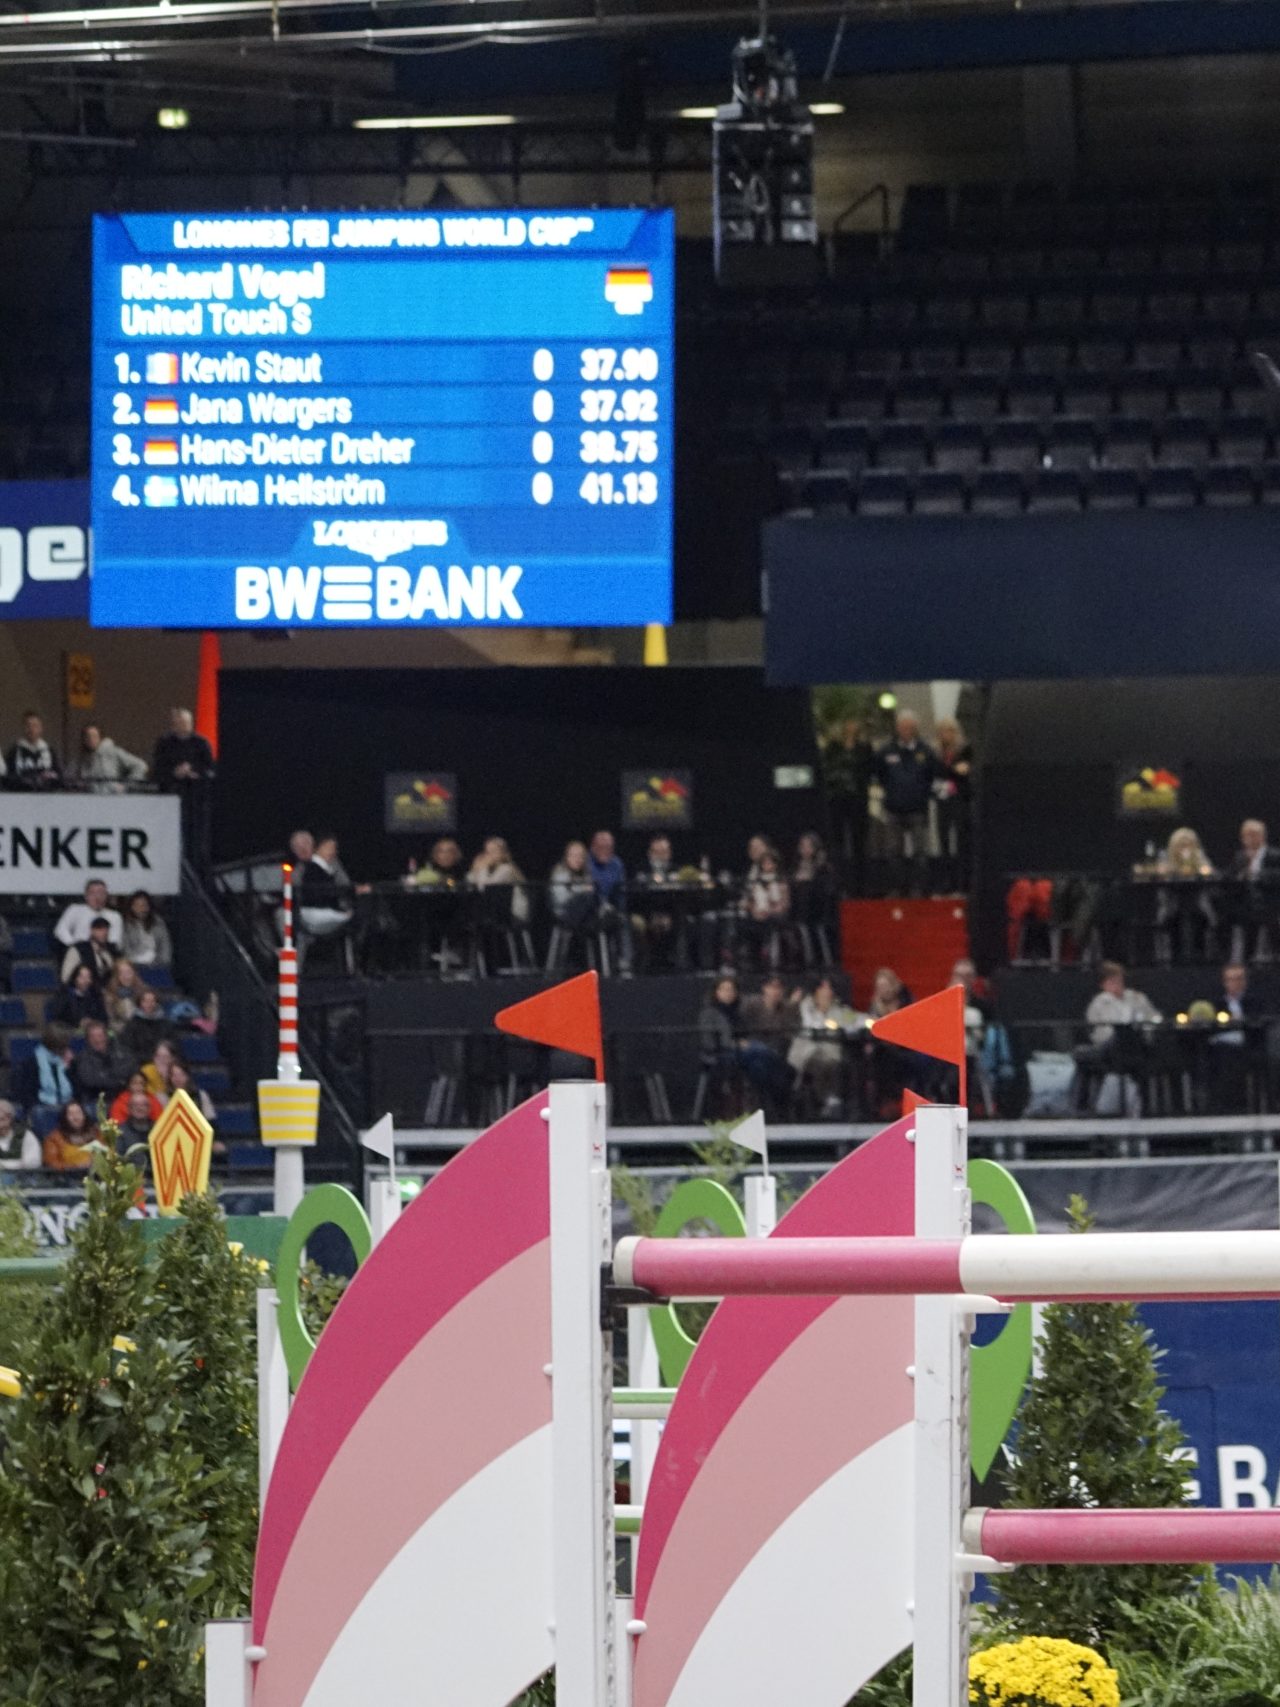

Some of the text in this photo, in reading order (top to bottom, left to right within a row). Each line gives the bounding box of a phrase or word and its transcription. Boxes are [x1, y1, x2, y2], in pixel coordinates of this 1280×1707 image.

[292, 219, 329, 247] FEI
[332, 218, 440, 247] JUMPING
[442, 217, 526, 246] WORLD
[122, 261, 325, 307] Richard Vogel
[121, 301, 311, 335] United Touch S
[114, 352, 141, 384] 1.
[181, 351, 250, 383] Kevin
[255, 350, 322, 383] Staut
[532, 348, 554, 381] 0
[112, 388, 659, 430] 2. Jana Wargers 0 37.92
[112, 433, 141, 465] 3.
[181, 431, 327, 465] Hans-Dieter
[331, 431, 415, 465] Dreher
[532, 430, 554, 464] 0
[112, 471, 658, 507] 4. Wilma Hellström 0 41.13
[0, 826, 152, 870] NKER
